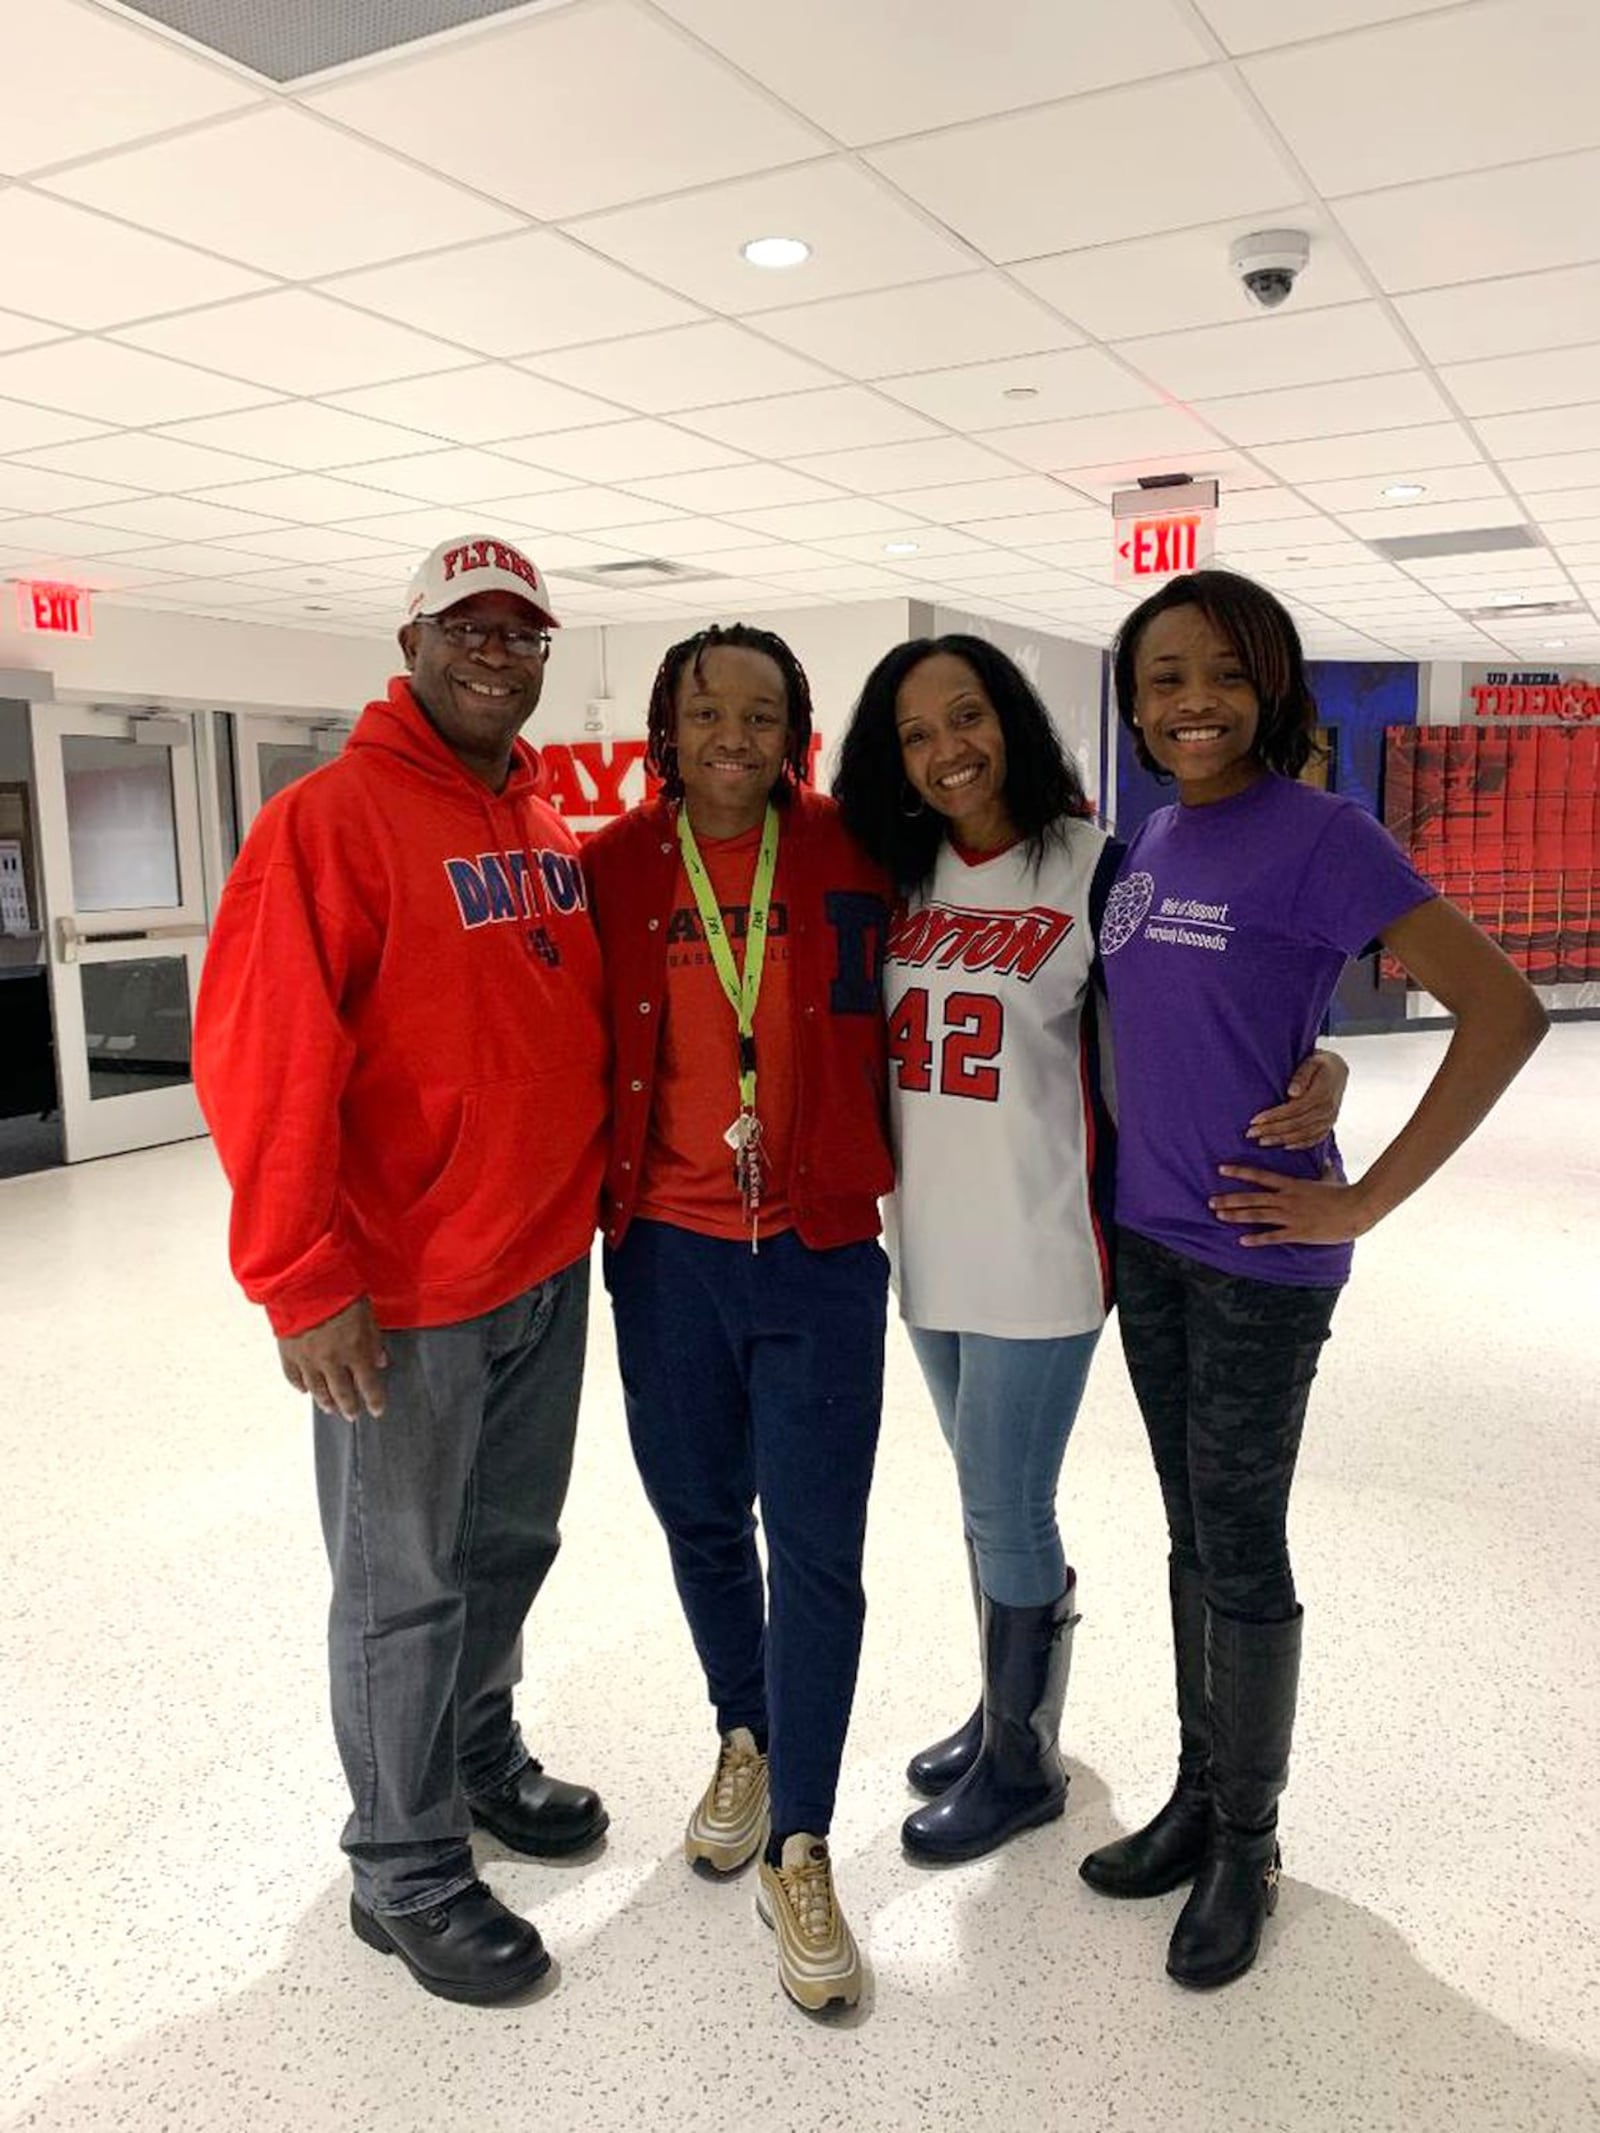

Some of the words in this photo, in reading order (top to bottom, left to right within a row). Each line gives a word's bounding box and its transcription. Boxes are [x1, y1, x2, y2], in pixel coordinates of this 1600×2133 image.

[444, 540, 538, 591] FLYERS
[1134, 516, 1201, 573] EXIT
[32, 581, 79, 632] EXIT
[1487, 672, 1507, 686] UD
[1511, 672, 1561, 686] ARENA
[888, 987, 1004, 1102] 42
